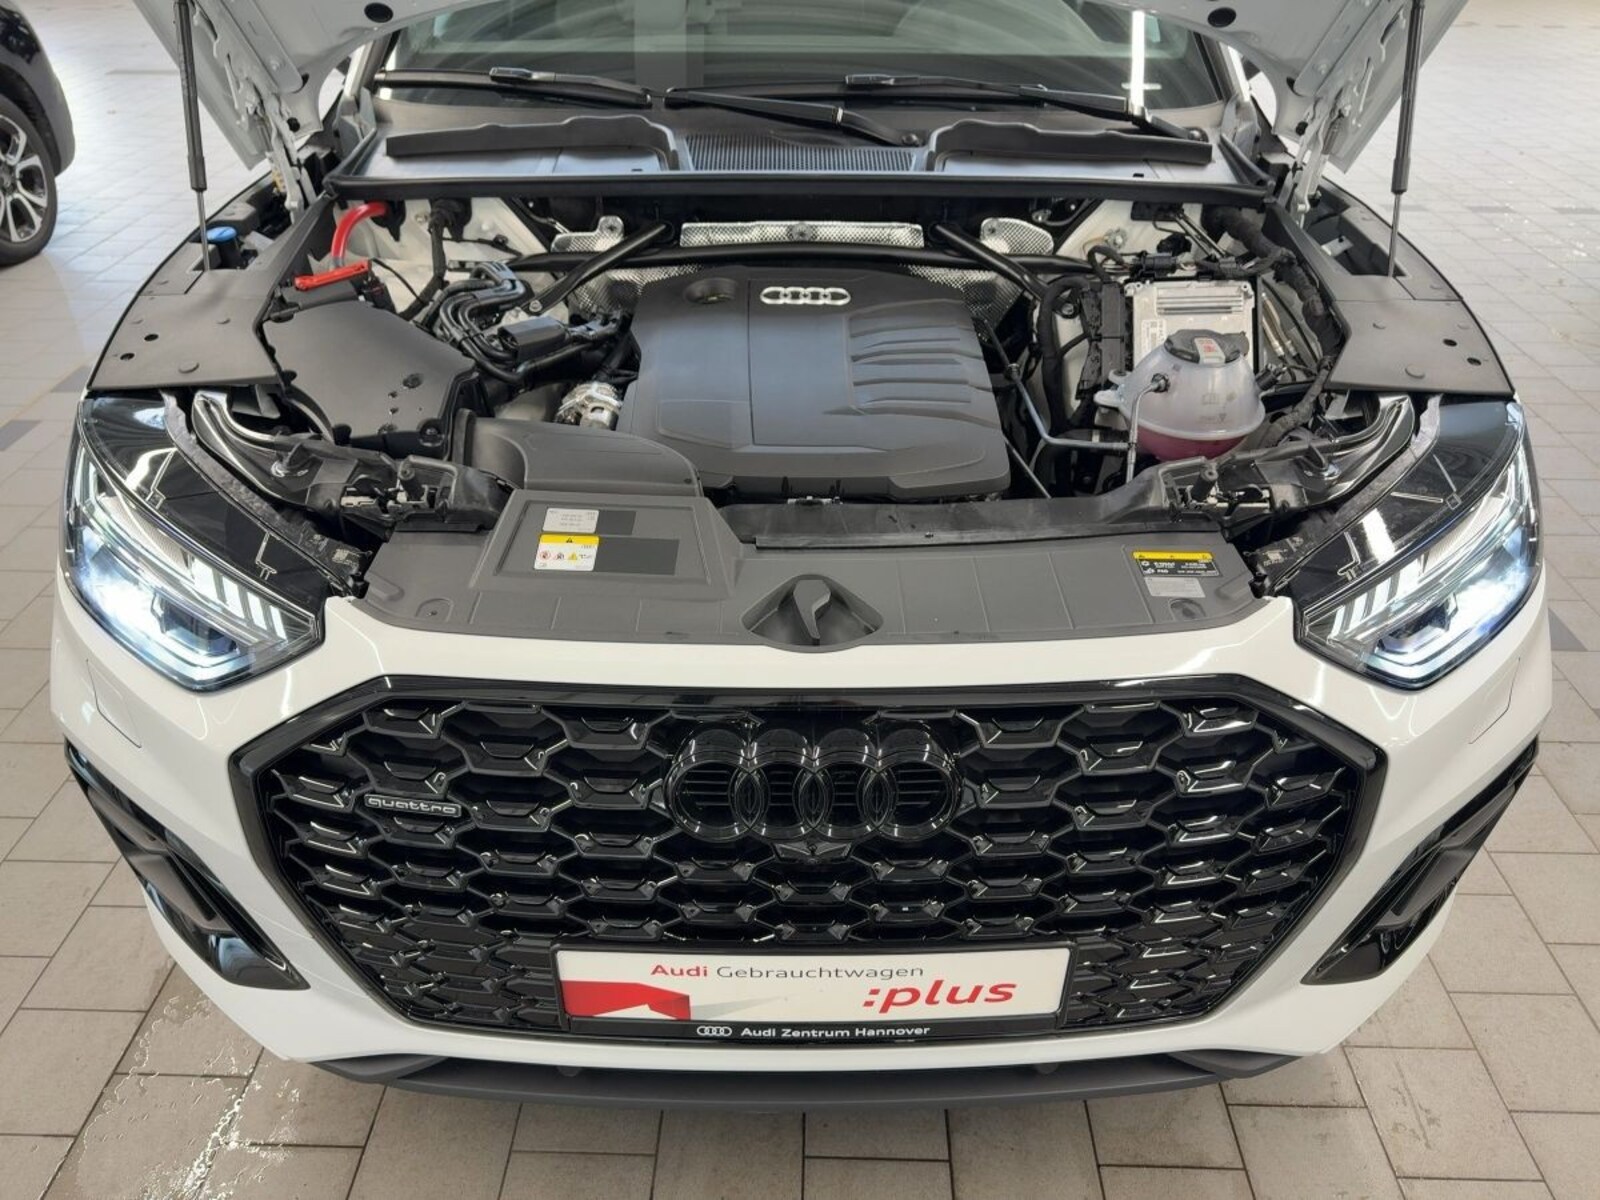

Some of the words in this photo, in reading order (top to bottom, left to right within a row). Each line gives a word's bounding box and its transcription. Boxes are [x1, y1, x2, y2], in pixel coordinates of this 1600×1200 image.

[368, 797, 457, 814] quattro
[651, 964, 708, 978] Audi
[717, 965, 924, 980] Gebrauchtwagen
[863, 979, 1017, 1013] :plus
[741, 1026, 776, 1038] Audi
[781, 1026, 850, 1038] Zentrum
[855, 1025, 930, 1038] Hannover
